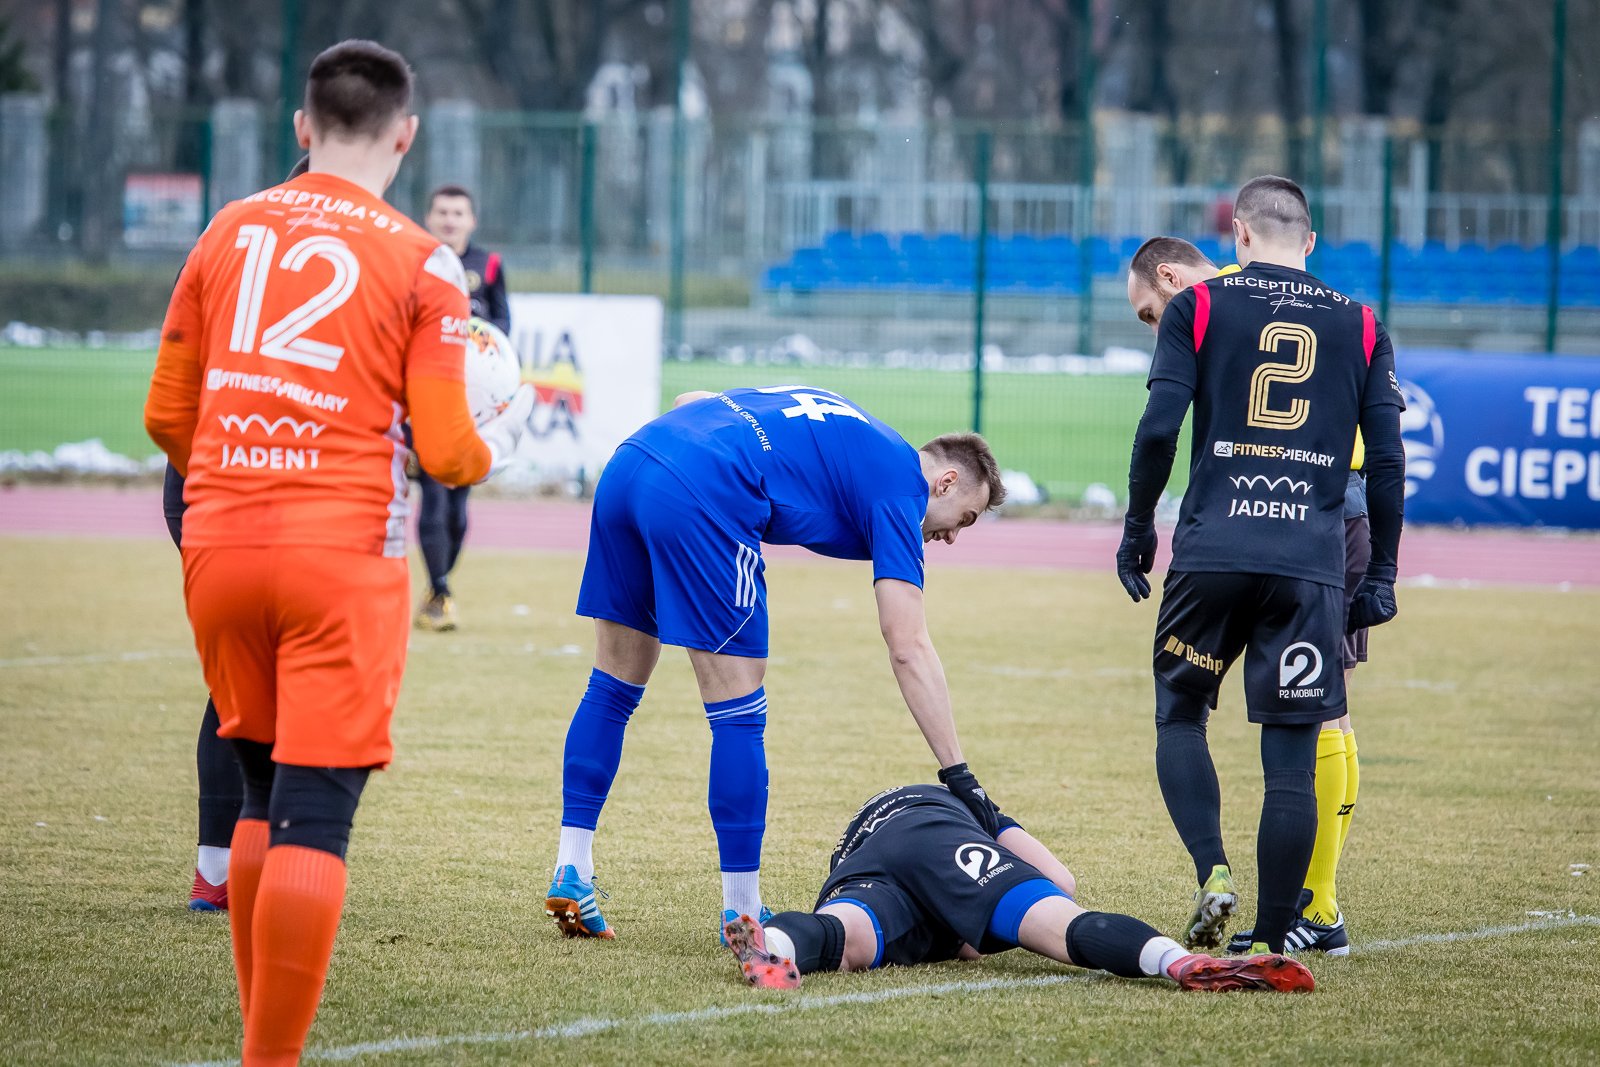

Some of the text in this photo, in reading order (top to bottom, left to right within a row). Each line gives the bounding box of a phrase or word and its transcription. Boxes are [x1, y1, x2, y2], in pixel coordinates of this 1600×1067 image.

[229, 223, 361, 373] 12
[1246, 321, 1318, 431] 2
[220, 444, 321, 470] JADENT
[1228, 498, 1309, 522] JADENT
[1279, 688, 1325, 699] P2 MOBILITY
[977, 862, 1014, 887] P2 MOBILITY
